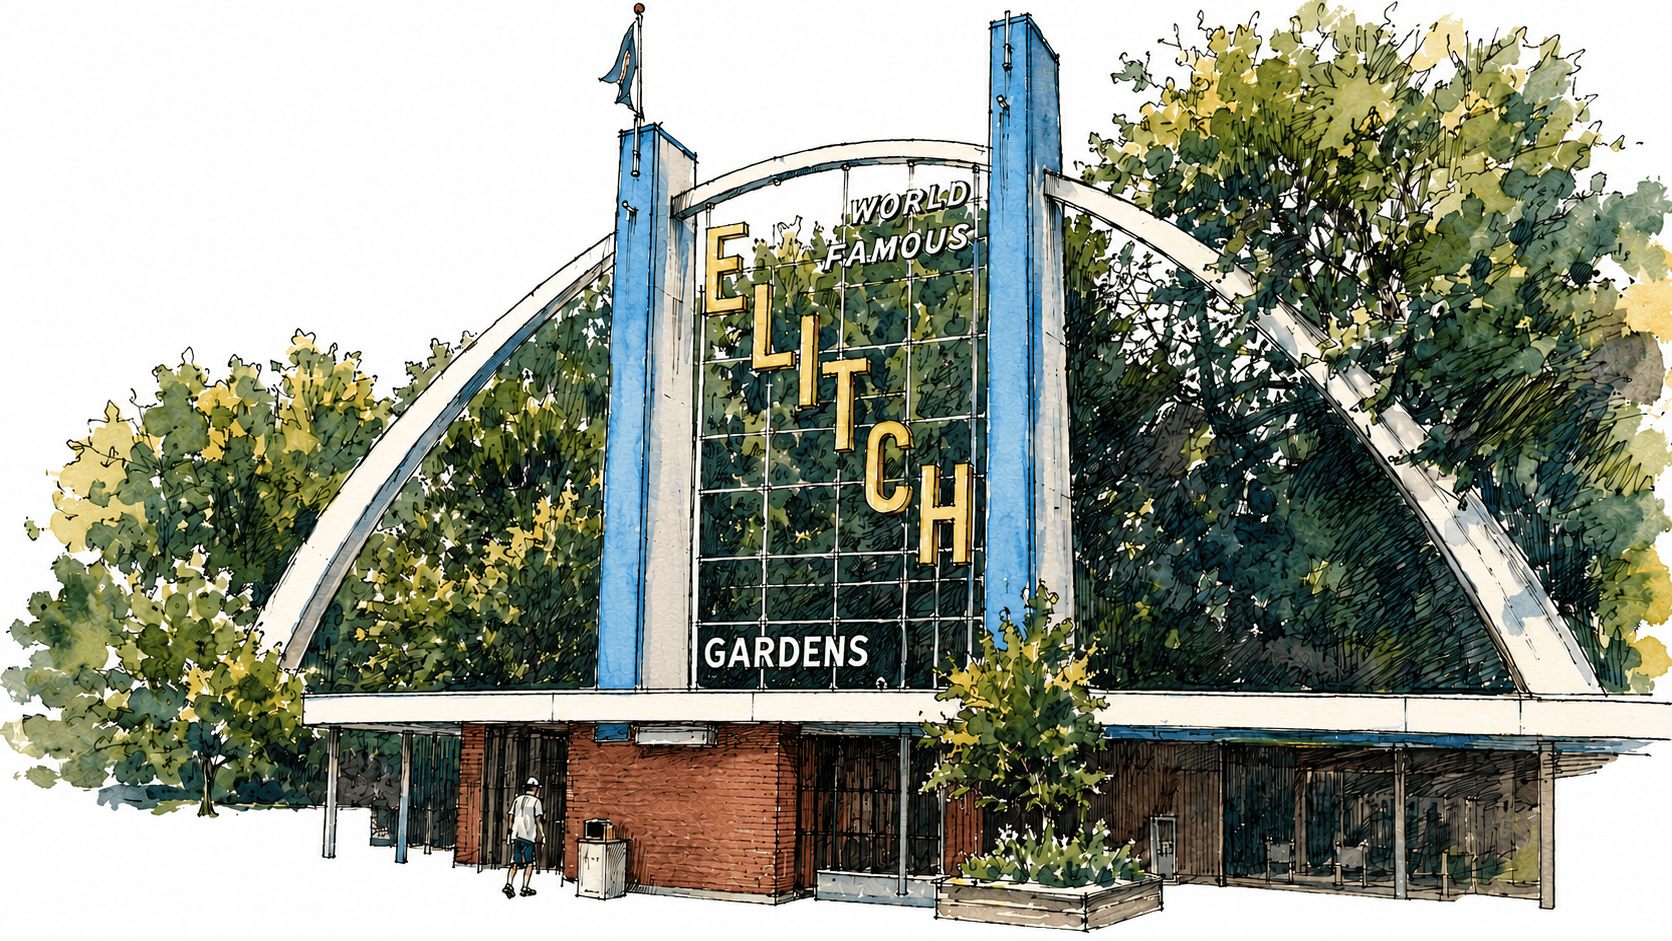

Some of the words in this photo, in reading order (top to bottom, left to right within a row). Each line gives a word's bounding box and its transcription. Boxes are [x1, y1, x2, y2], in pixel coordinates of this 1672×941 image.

[851, 181, 970, 226] WORLD
[823, 223, 970, 272] FAMOUS
[705, 221, 973, 567] ELITCH
[704, 635, 869, 668] GARDENS
